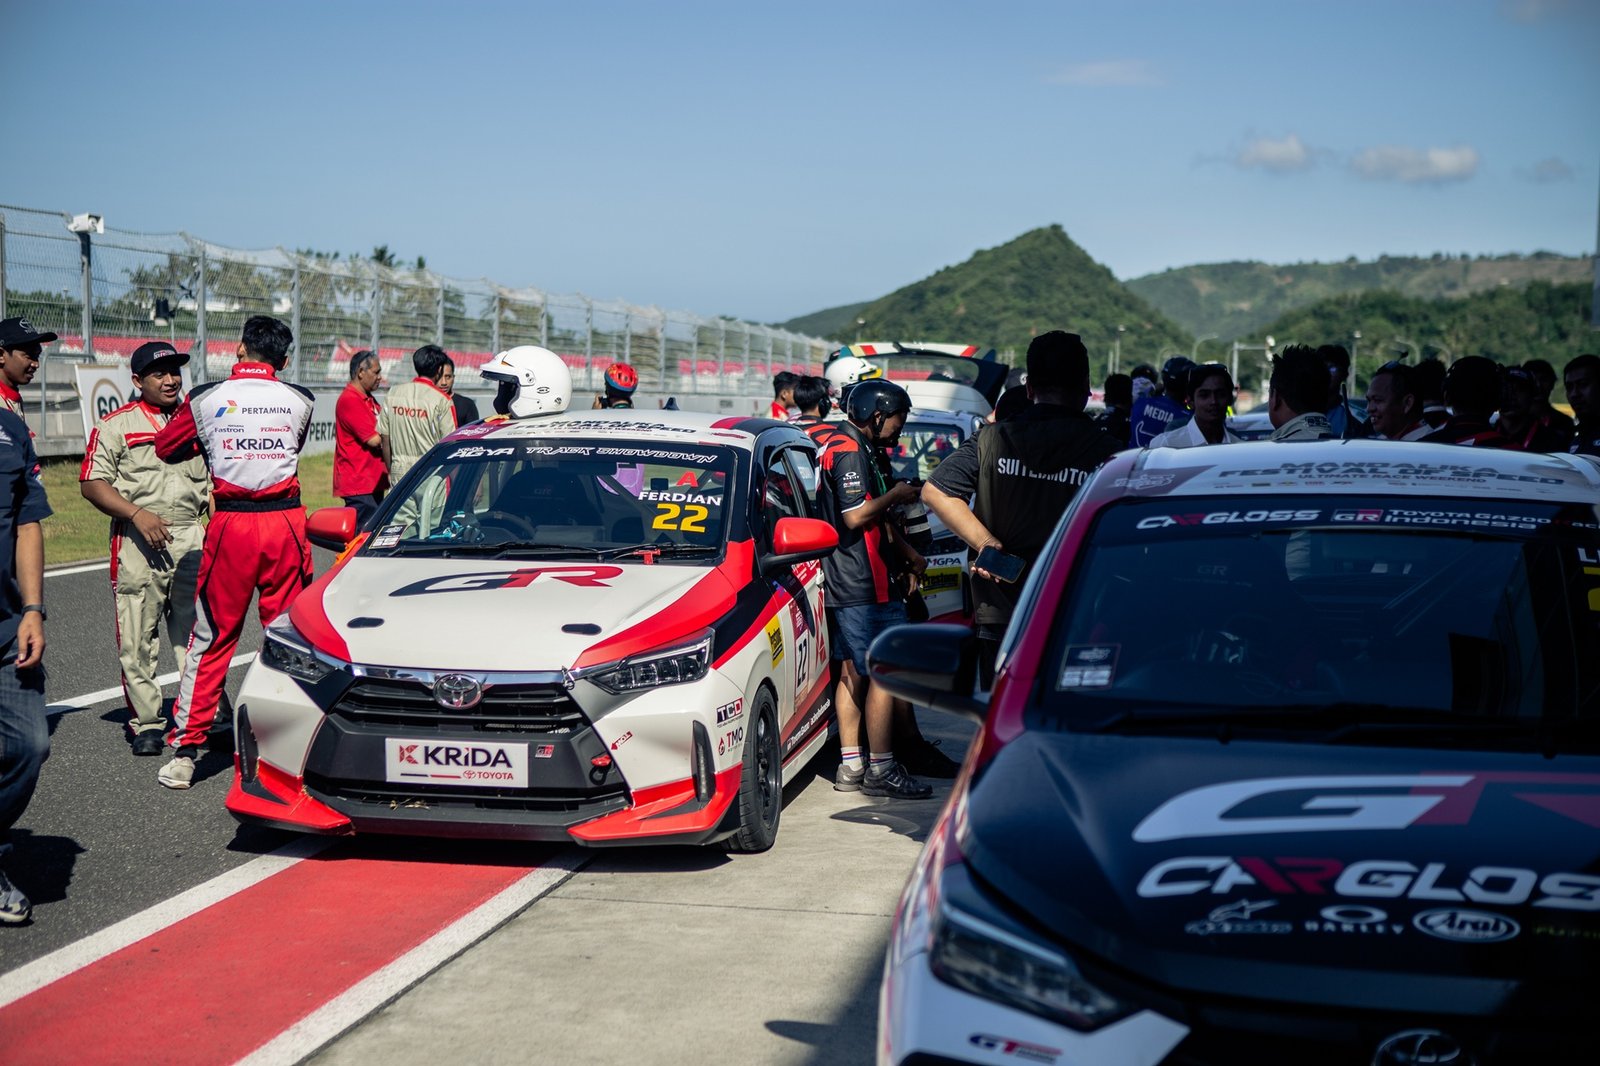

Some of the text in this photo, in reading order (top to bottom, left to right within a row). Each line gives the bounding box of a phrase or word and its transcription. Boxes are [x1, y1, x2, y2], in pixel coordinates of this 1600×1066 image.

[242, 407, 292, 415] PERTAMINA
[392, 406, 429, 419] TOYOTA
[1144, 404, 1174, 422] MEDIA
[597, 447, 718, 464] SHOWDOWN
[1219, 467, 1565, 485] FESTIVAL OF SPEED
[1281, 462, 1499, 474] MANDALIKA
[676, 471, 699, 488] A
[1416, 475, 1487, 483] WEEKEND
[638, 491, 722, 506] FERDIAN
[652, 503, 709, 533] 22
[1136, 510, 1322, 529] CARGLOSS
[1334, 512, 1380, 522] GR
[1389, 509, 1472, 518] TOYOTA
[1474, 512, 1552, 524] GAZOO
[389, 566, 624, 597] GR
[717, 700, 742, 721] TCD
[726, 726, 744, 748] TMO
[477, 771, 514, 780] TOYOTA
